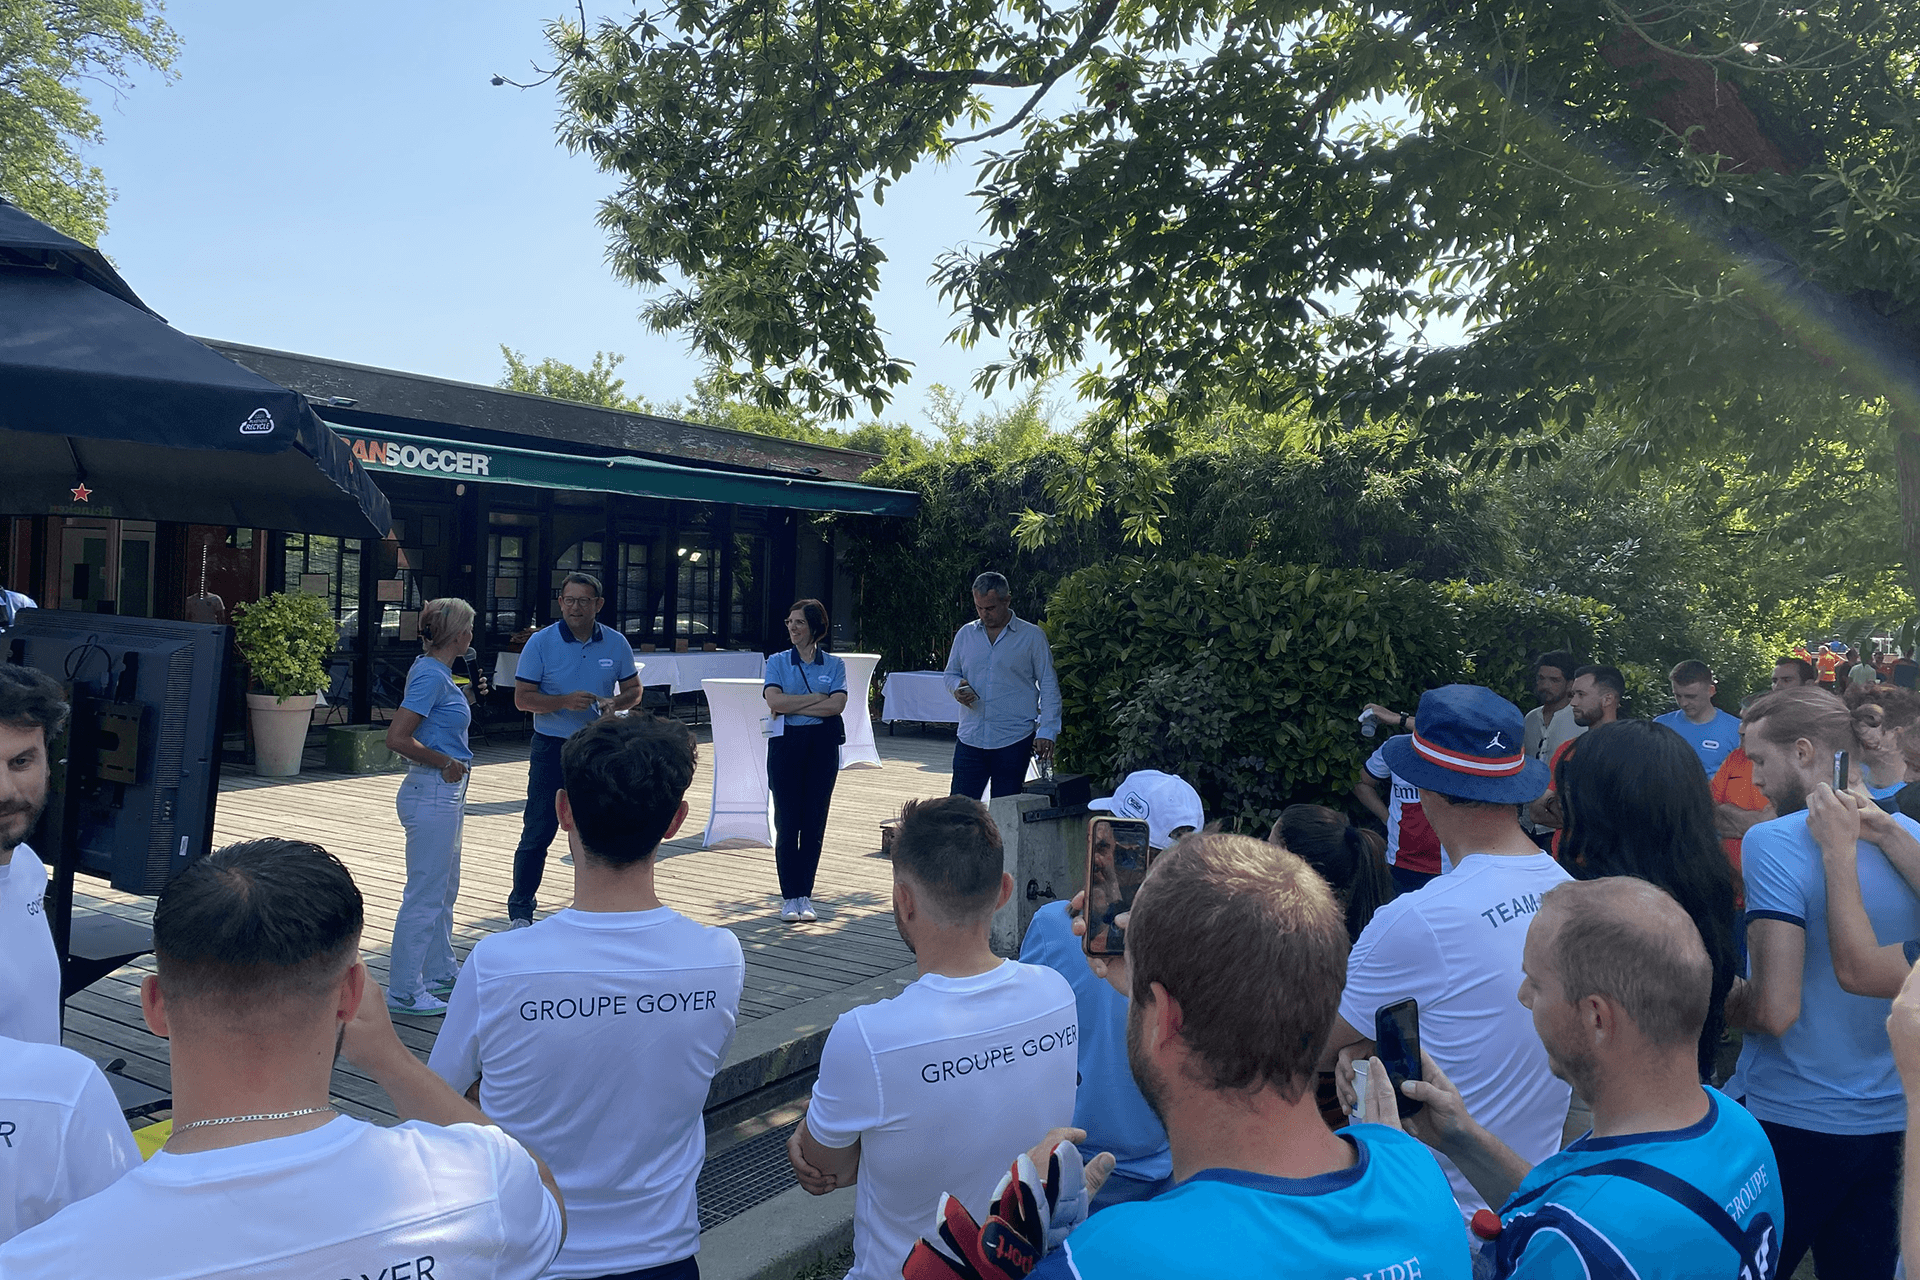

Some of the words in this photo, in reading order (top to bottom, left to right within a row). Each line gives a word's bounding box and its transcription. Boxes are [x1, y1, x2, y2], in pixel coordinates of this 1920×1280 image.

[341, 437, 490, 475] ANSOCCER
[1480, 893, 1539, 929] TEAM
[519, 995, 627, 1021] GROUPE
[636, 990, 717, 1014] GOYER
[921, 1046, 1016, 1084] GROUPE
[1022, 1024, 1078, 1057] GOYER
